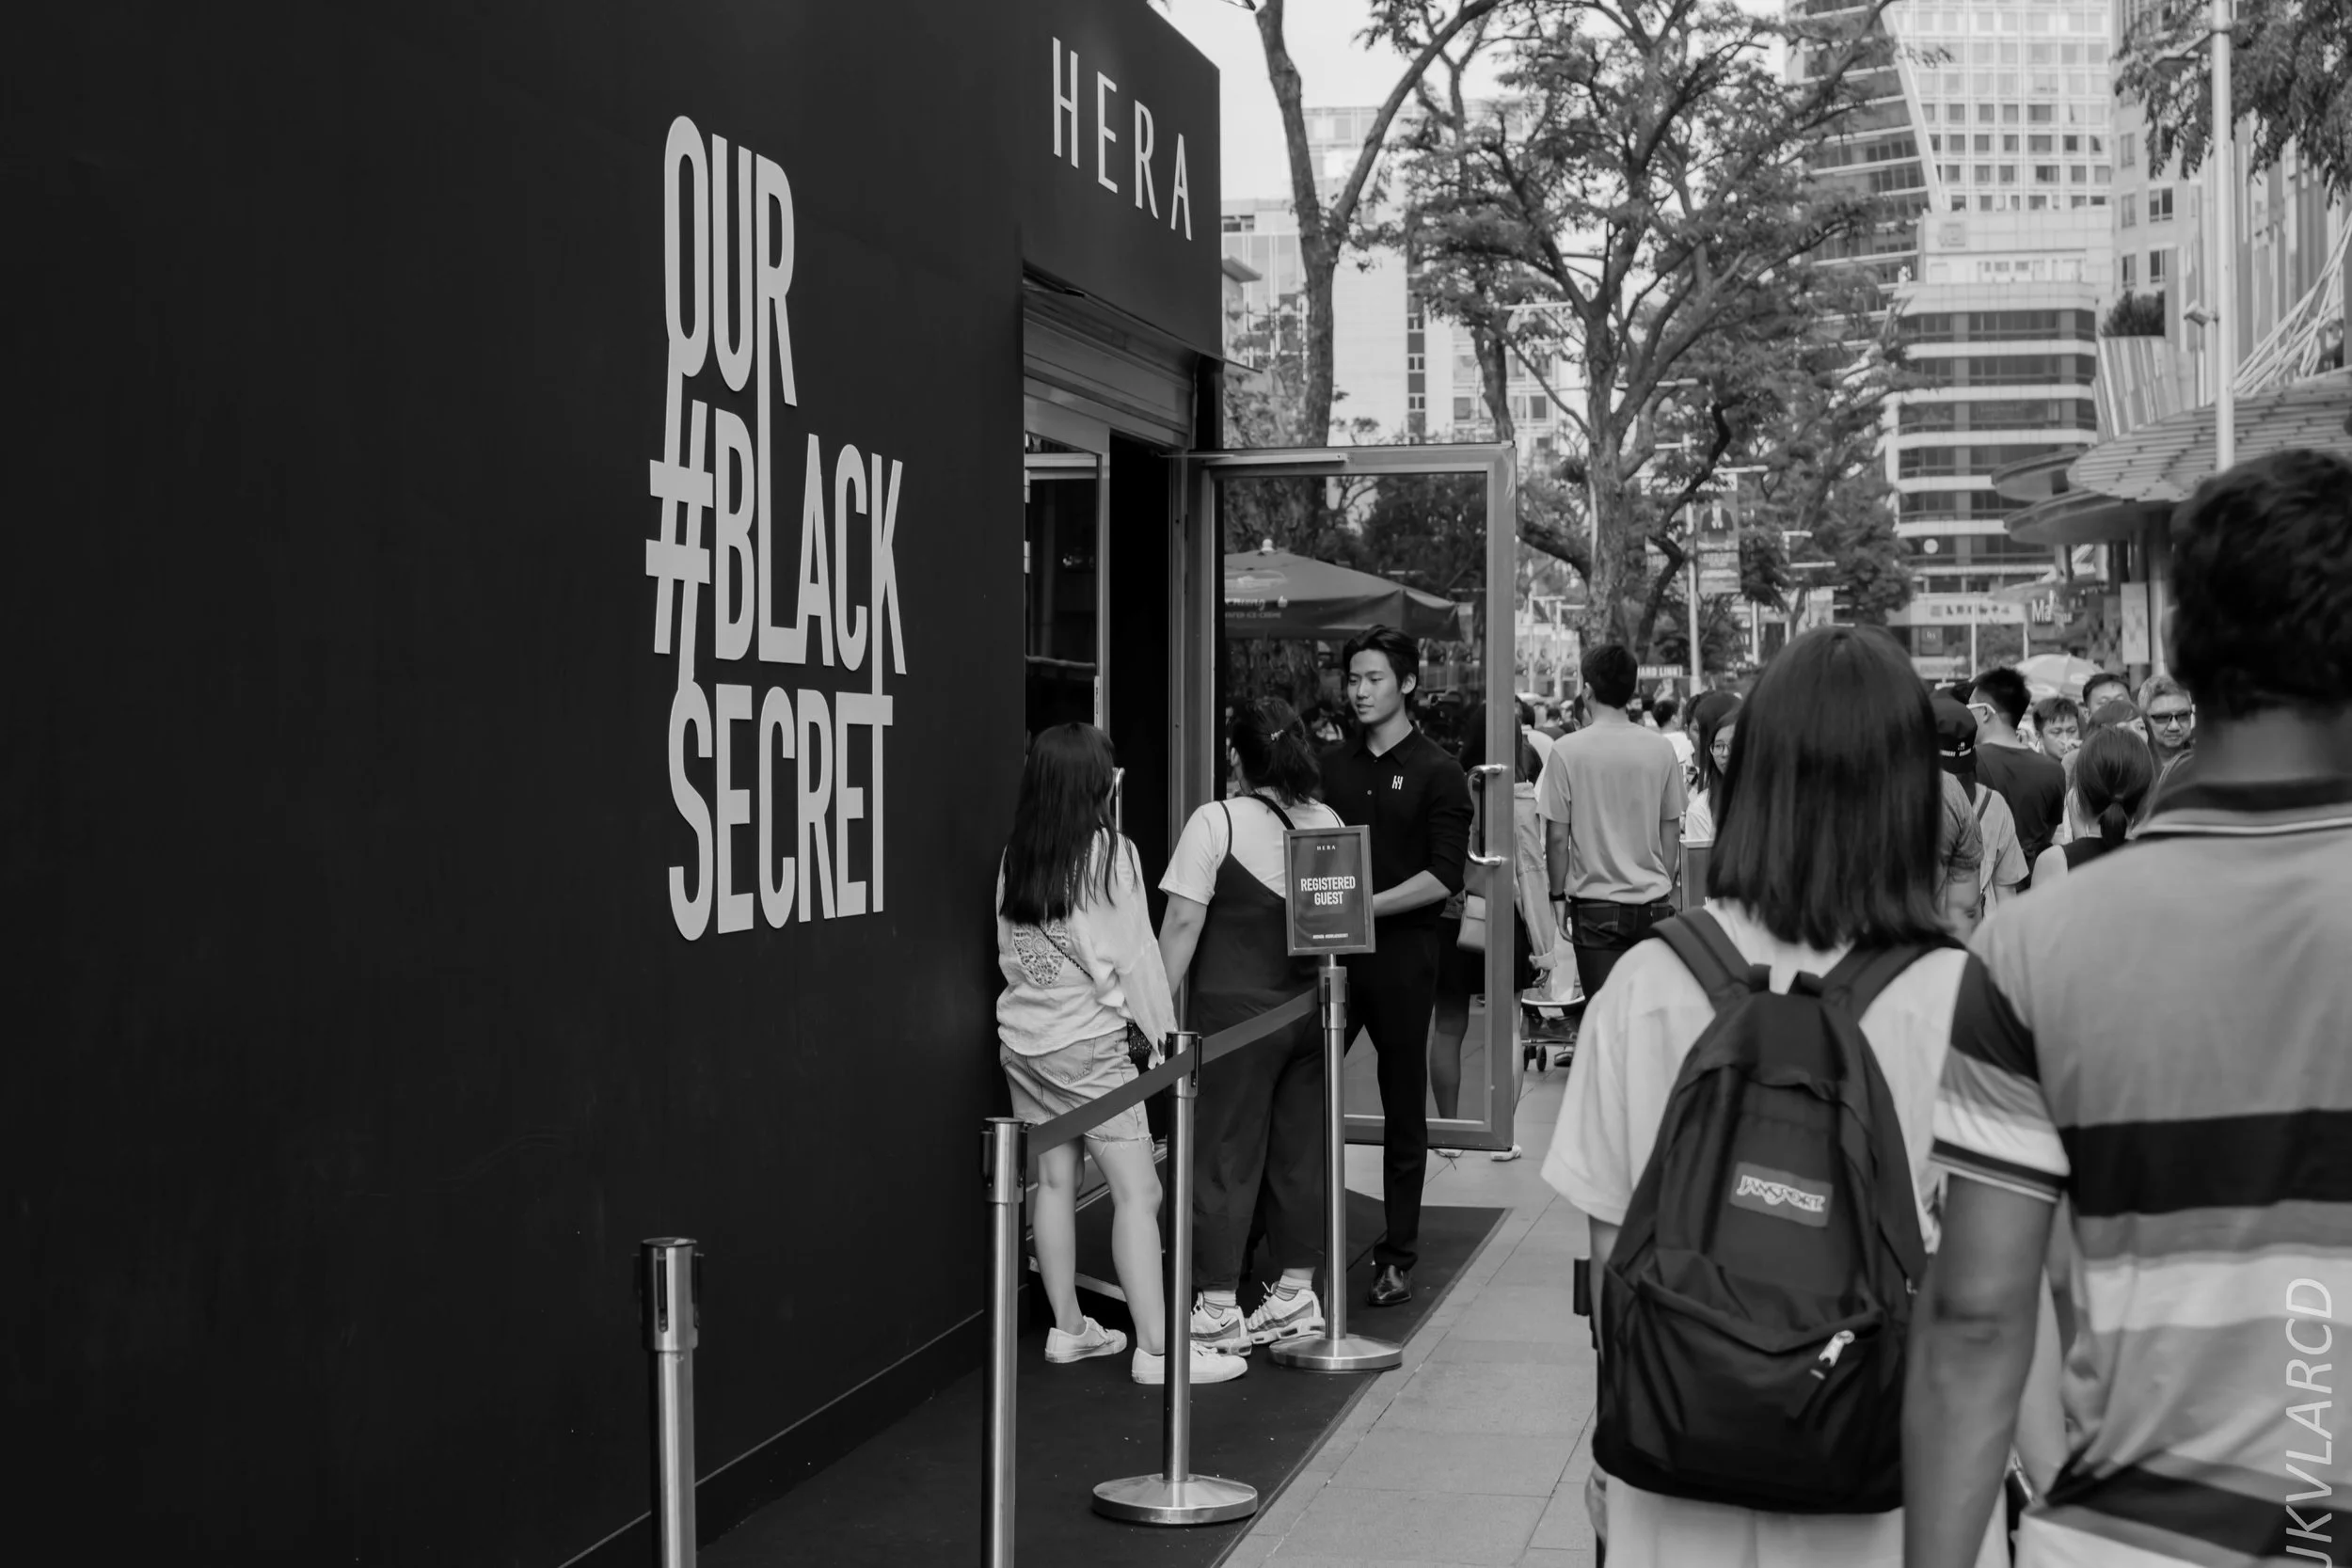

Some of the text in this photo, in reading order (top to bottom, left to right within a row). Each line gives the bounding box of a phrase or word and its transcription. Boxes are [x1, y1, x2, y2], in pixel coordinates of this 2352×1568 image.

[1053, 37, 1192, 241] HERA
[664, 116, 798, 407] OUR
[645, 399, 907, 675] #BLACK
[668, 680, 894, 942] SECRET
[1300, 876, 1356, 892] REGISTERED
[1314, 892, 1343, 906] GUEST
